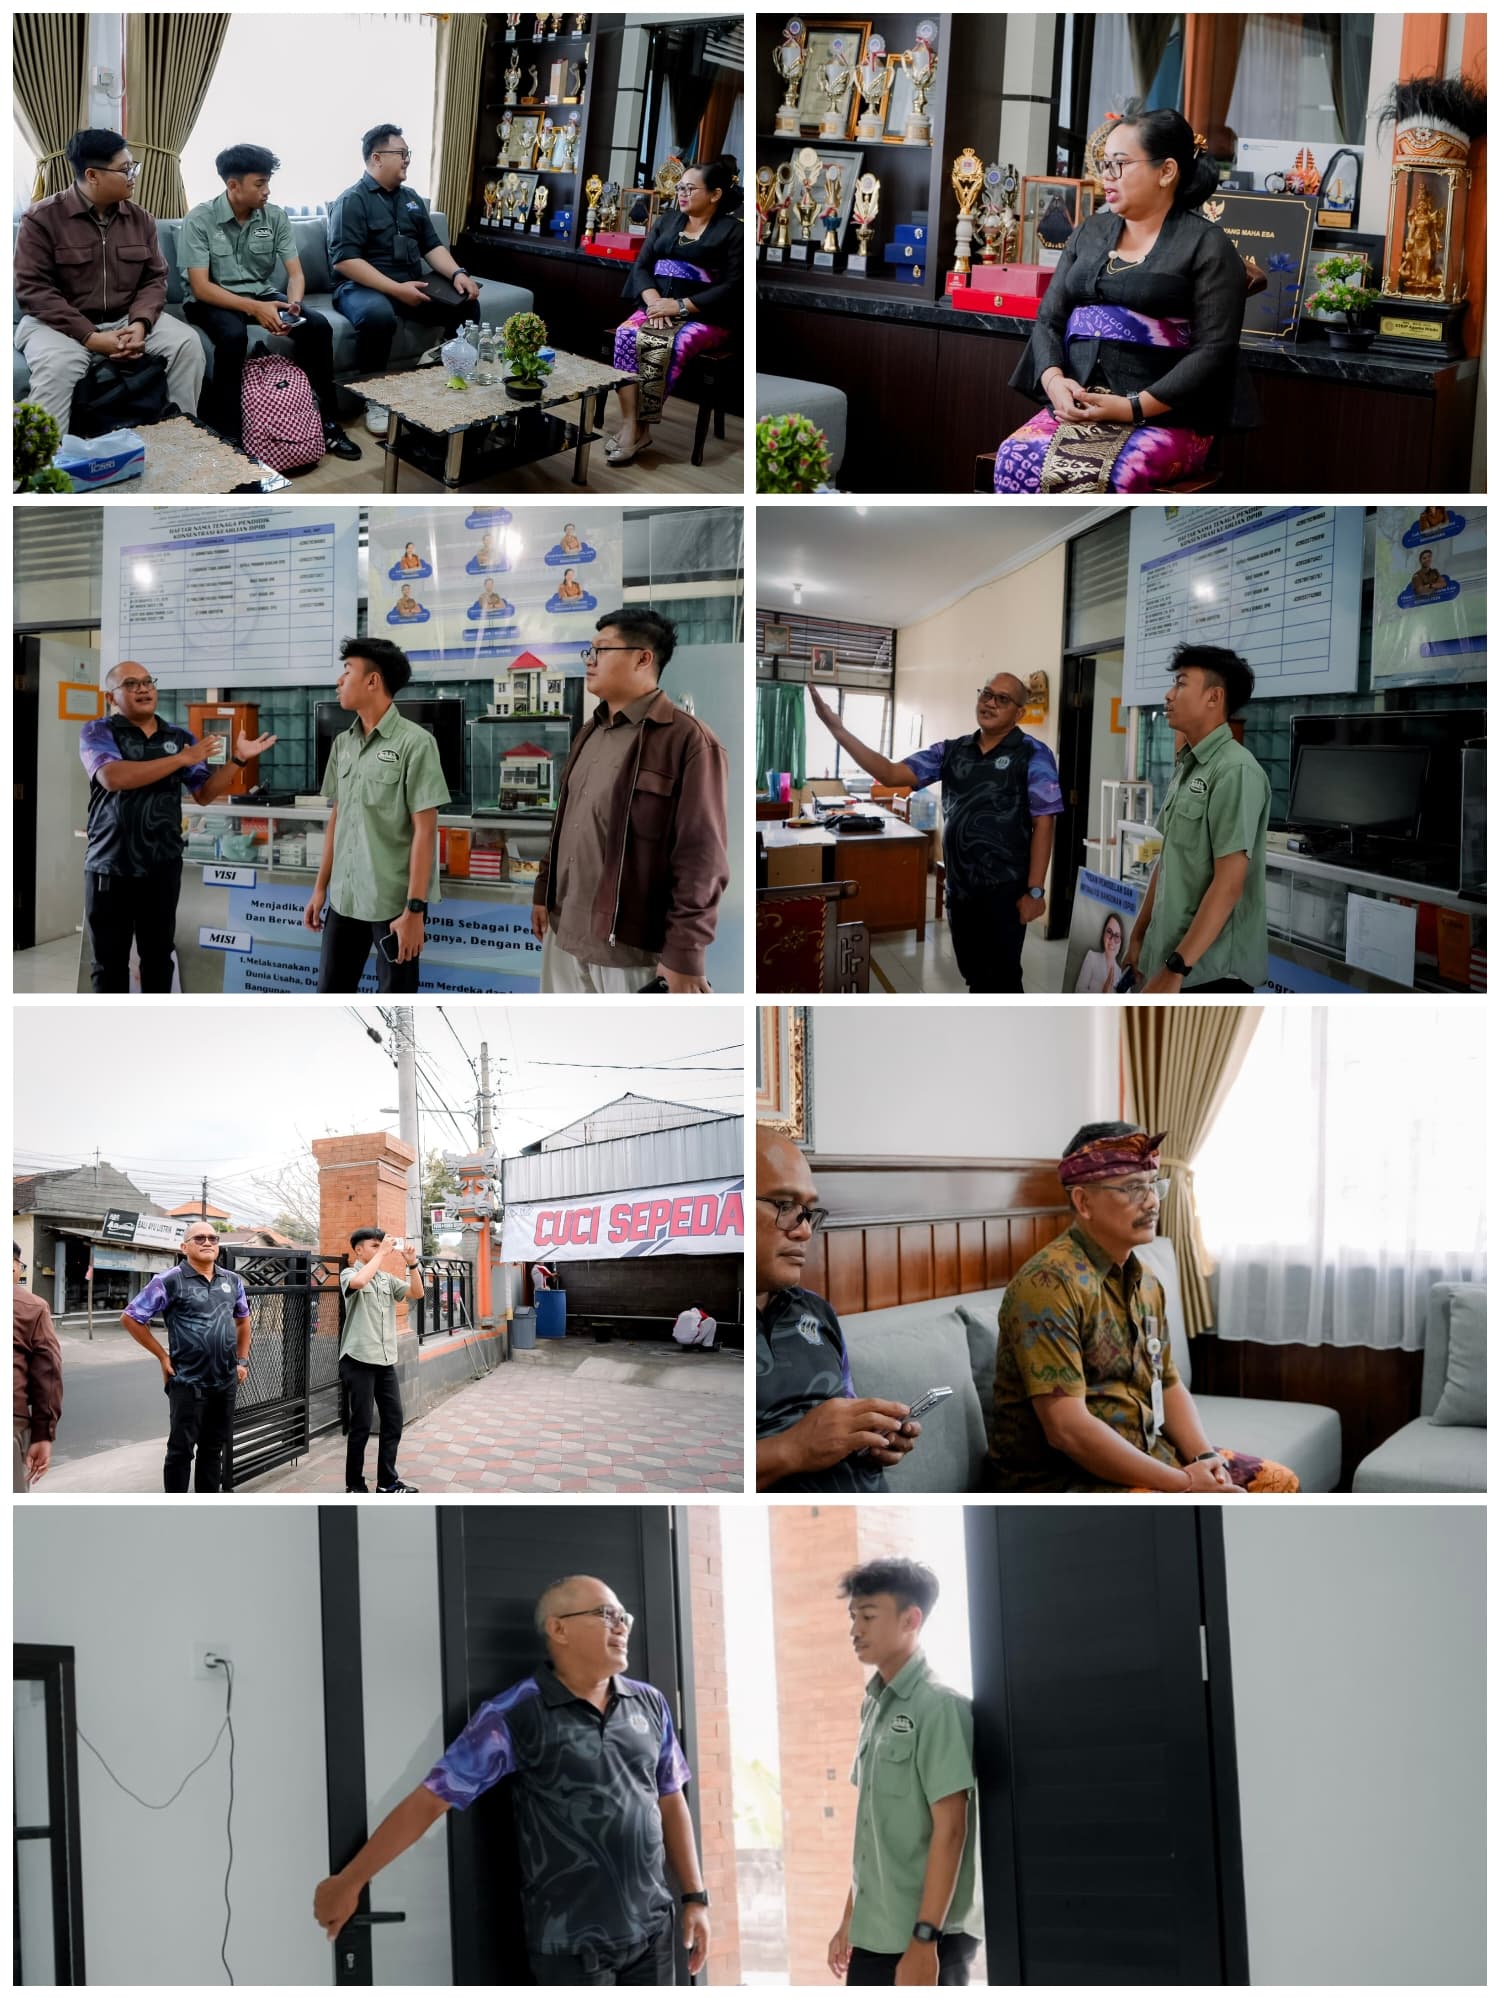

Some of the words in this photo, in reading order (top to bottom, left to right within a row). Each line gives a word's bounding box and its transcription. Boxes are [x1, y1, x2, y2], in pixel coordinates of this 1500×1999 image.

[1241, 229, 1260, 237] MAHA
[214, 870, 237, 880] VISI
[251, 900, 305, 912] Menjadika
[246, 913, 266, 922] Dan
[269, 915, 302, 926] Berwa
[458, 920, 509, 933] Sebagai
[209, 933, 236, 944] MISI
[424, 933, 467, 944] ngnya,
[470, 936, 520, 949] Dengan
[246, 970, 271, 980] Dunia
[436, 981, 484, 993] Merdeka
[533, 1205, 601, 1246] CUCI
[607, 1191, 744, 1244] SEPEDA
